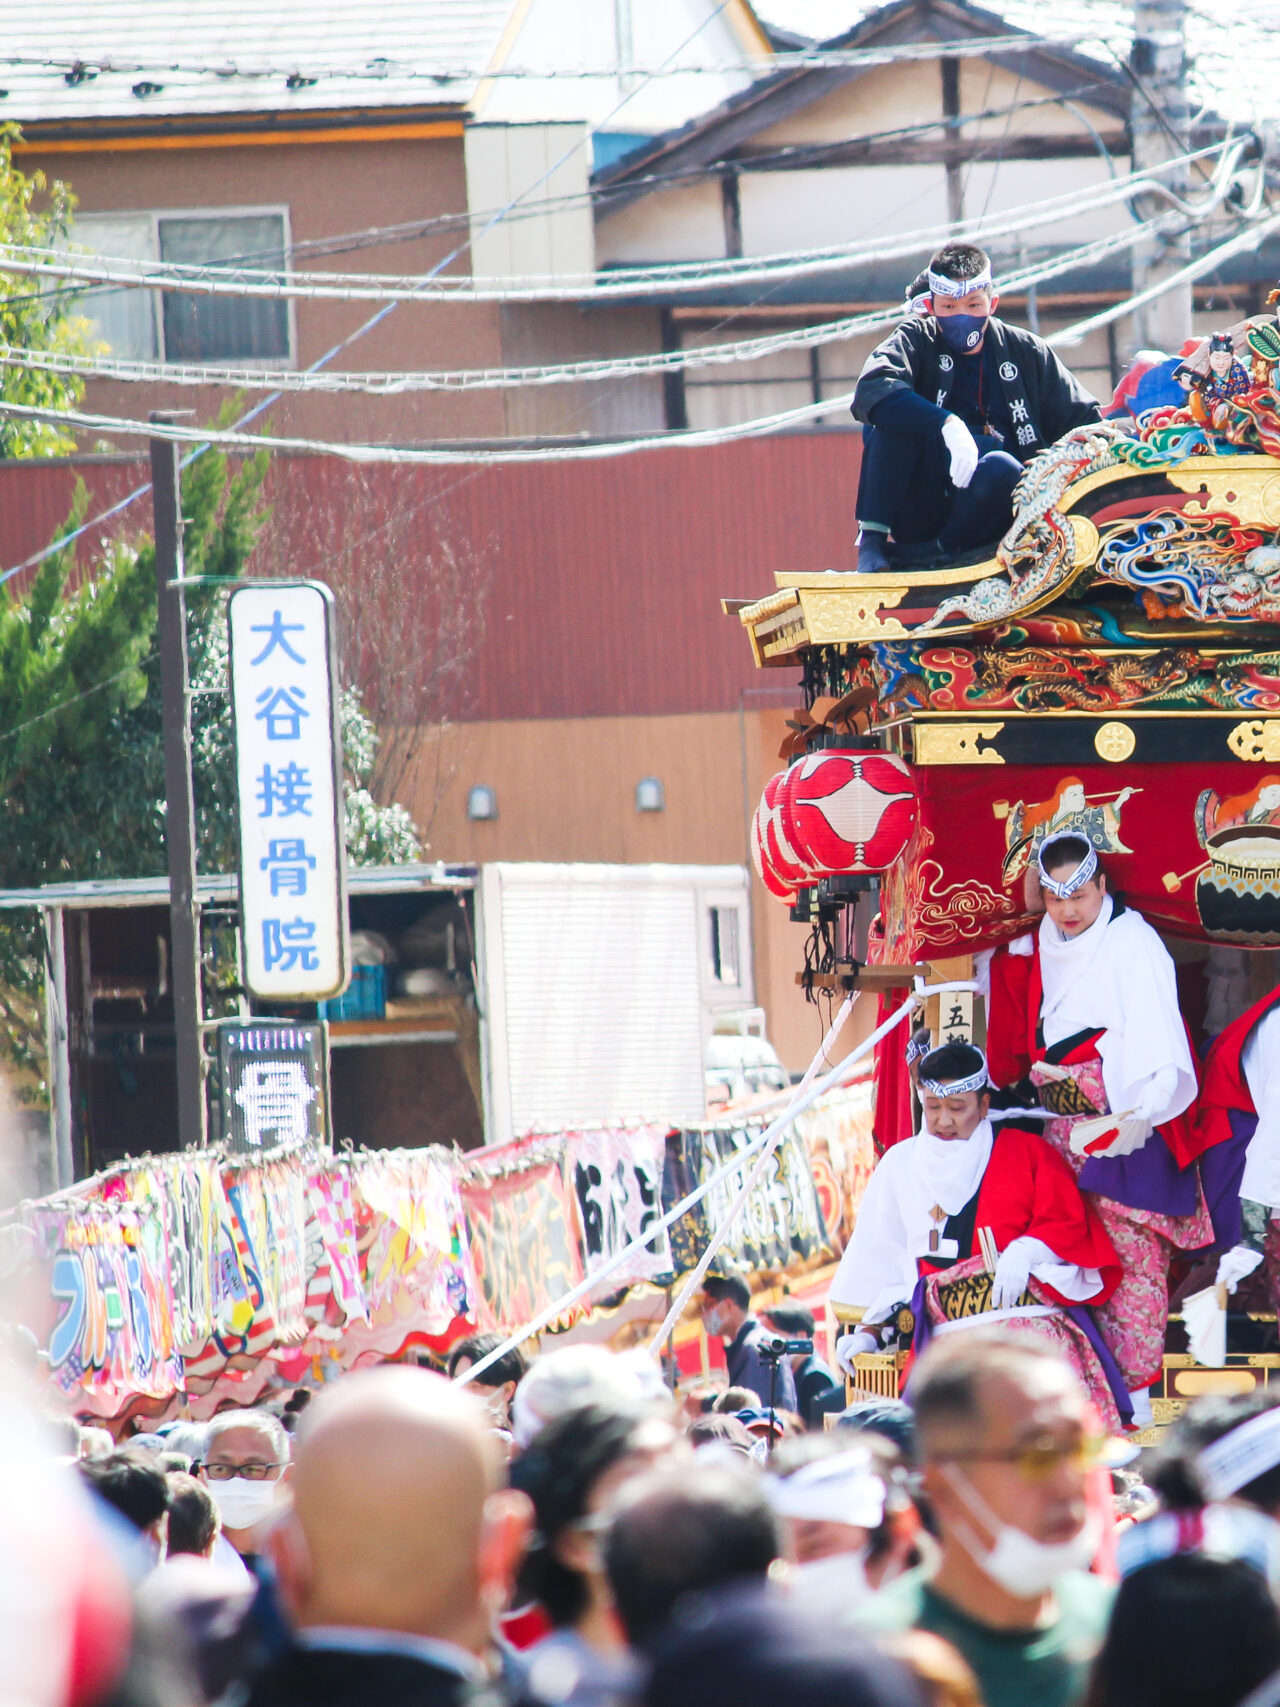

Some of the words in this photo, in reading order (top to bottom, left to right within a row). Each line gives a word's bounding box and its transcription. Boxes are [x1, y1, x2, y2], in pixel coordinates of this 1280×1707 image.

[250, 610, 320, 973] 大谷接骨院
[235, 1060, 315, 1146] 骨
